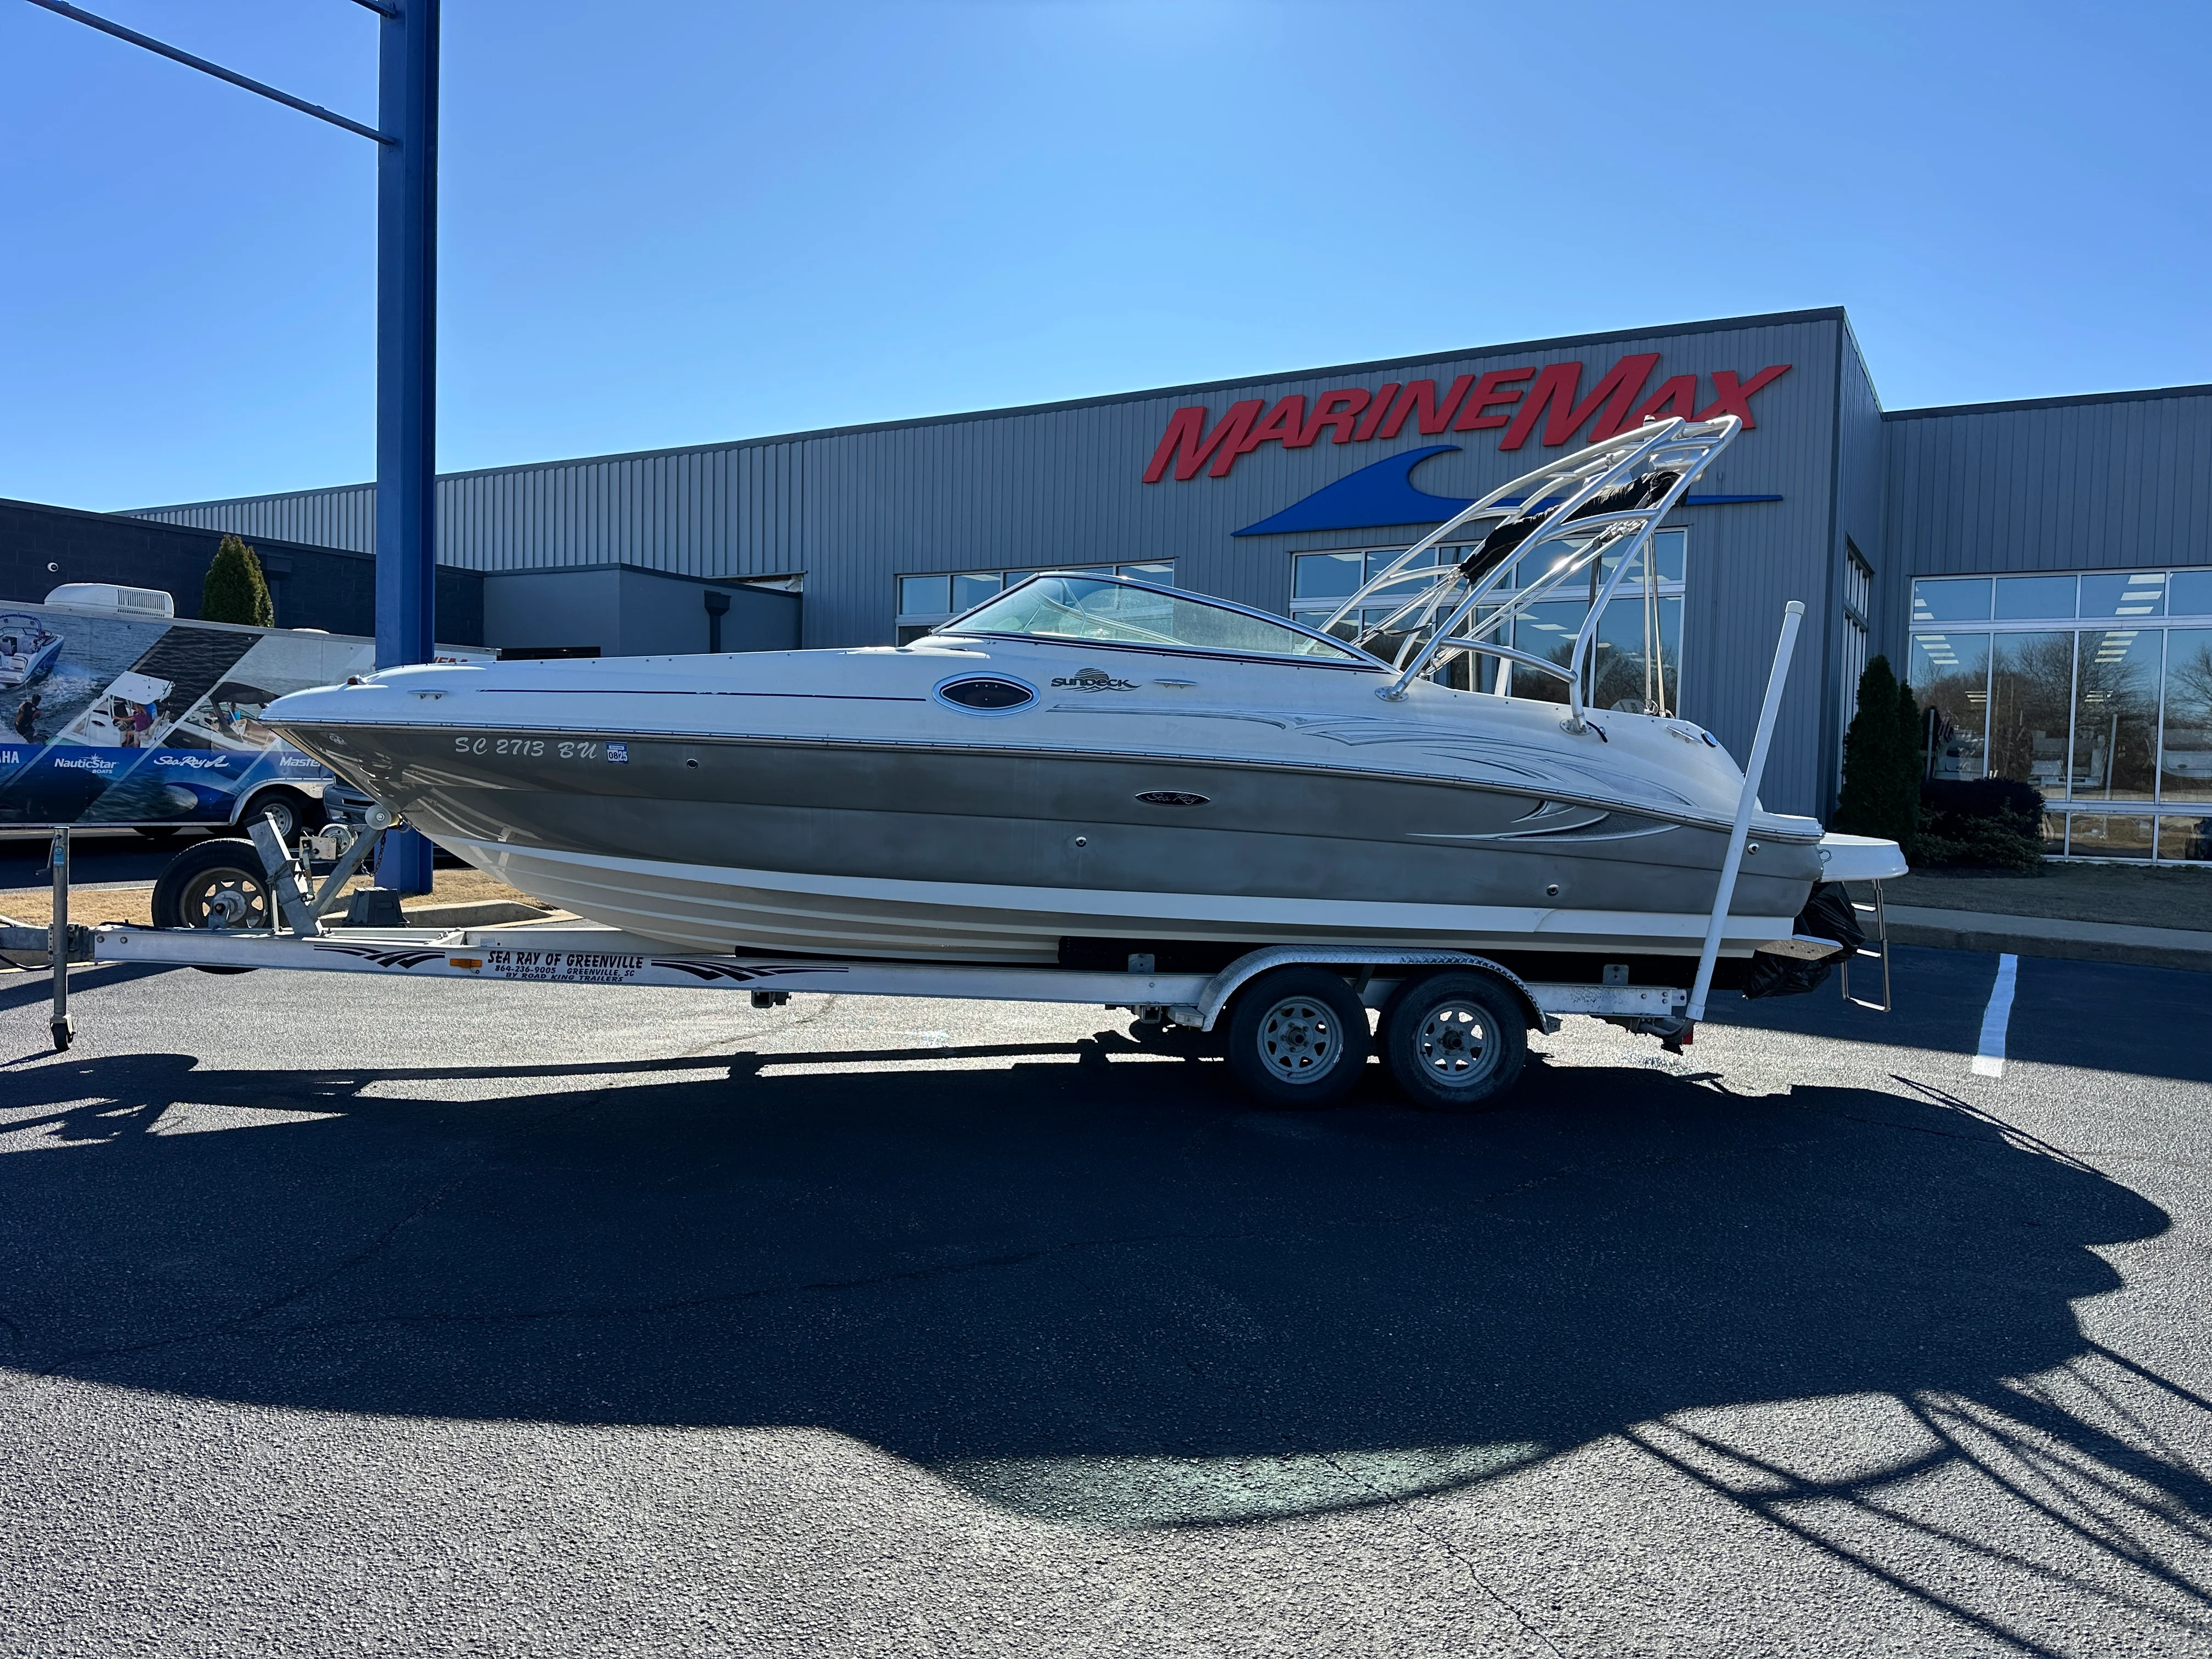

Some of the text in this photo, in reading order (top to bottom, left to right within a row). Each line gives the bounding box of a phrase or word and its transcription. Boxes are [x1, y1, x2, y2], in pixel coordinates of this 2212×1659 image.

[1142, 353, 1792, 484] MARINEMAX
[455, 737, 597, 759] SC 2713 BU
[0, 751, 20, 763] HA
[618, 751, 628, 761] 25
[54, 758, 117, 768] NauticStar
[1146, 793, 1199, 805] Sea Ray
[488, 951, 644, 968] SEA RAY OF GREENVILLE
[495, 965, 556, 974] 864-236-9005
[567, 968, 620, 977] GREENVILLE,
